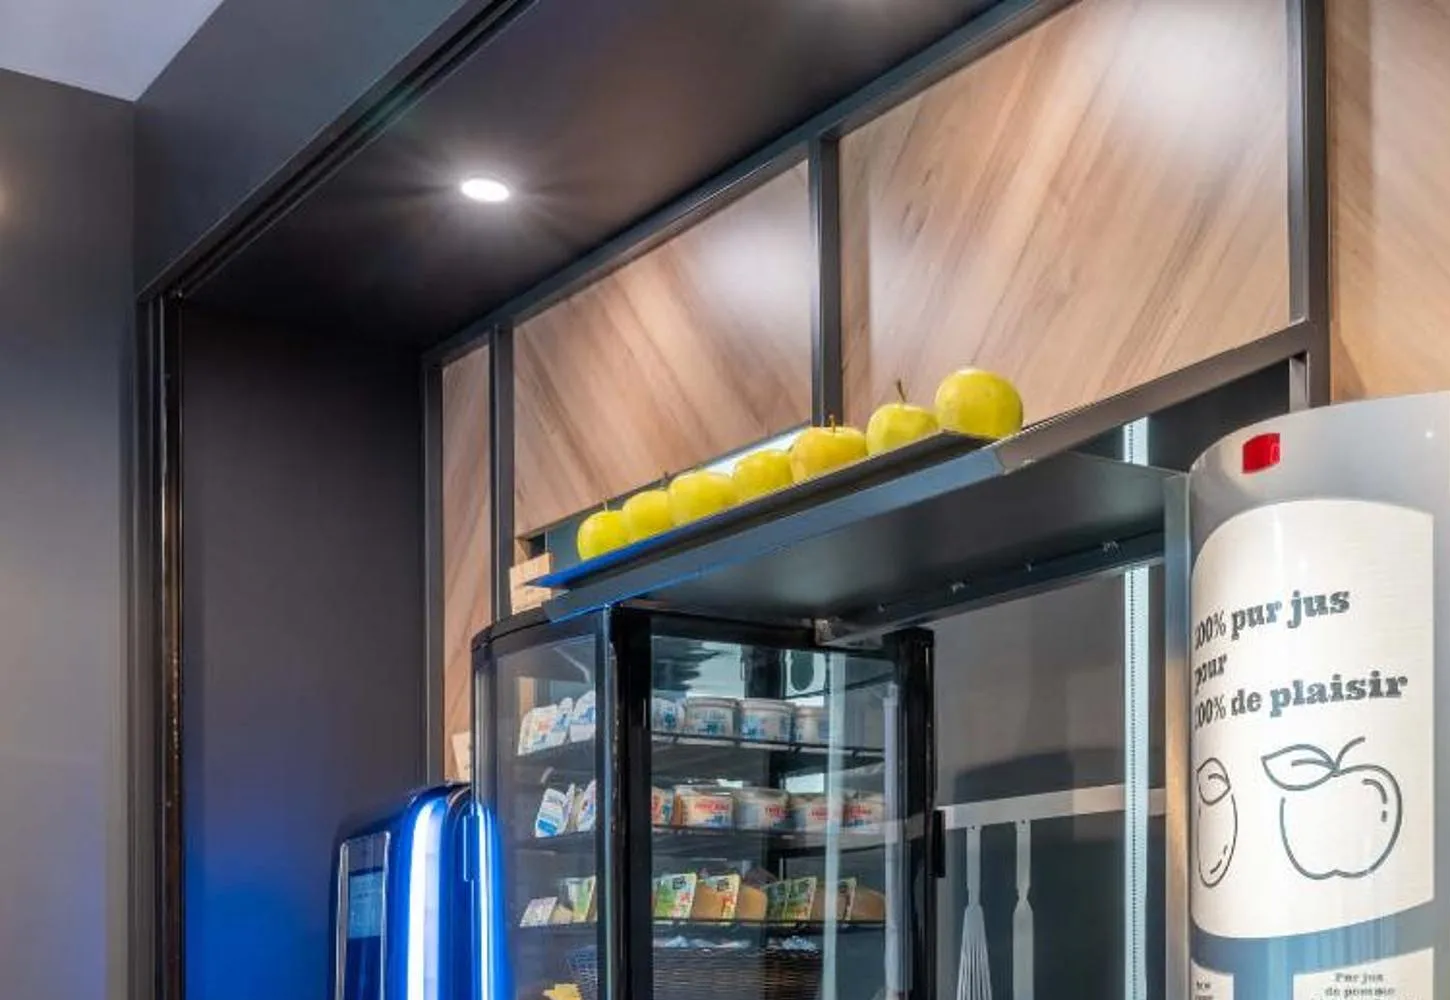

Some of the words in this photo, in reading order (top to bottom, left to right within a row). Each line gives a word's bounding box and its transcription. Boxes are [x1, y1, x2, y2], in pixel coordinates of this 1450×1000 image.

[1231, 600, 1282, 641] pur
[1287, 589, 1351, 629] jus
[1231, 688, 1262, 716] de
[1270, 670, 1408, 718] plaisir
